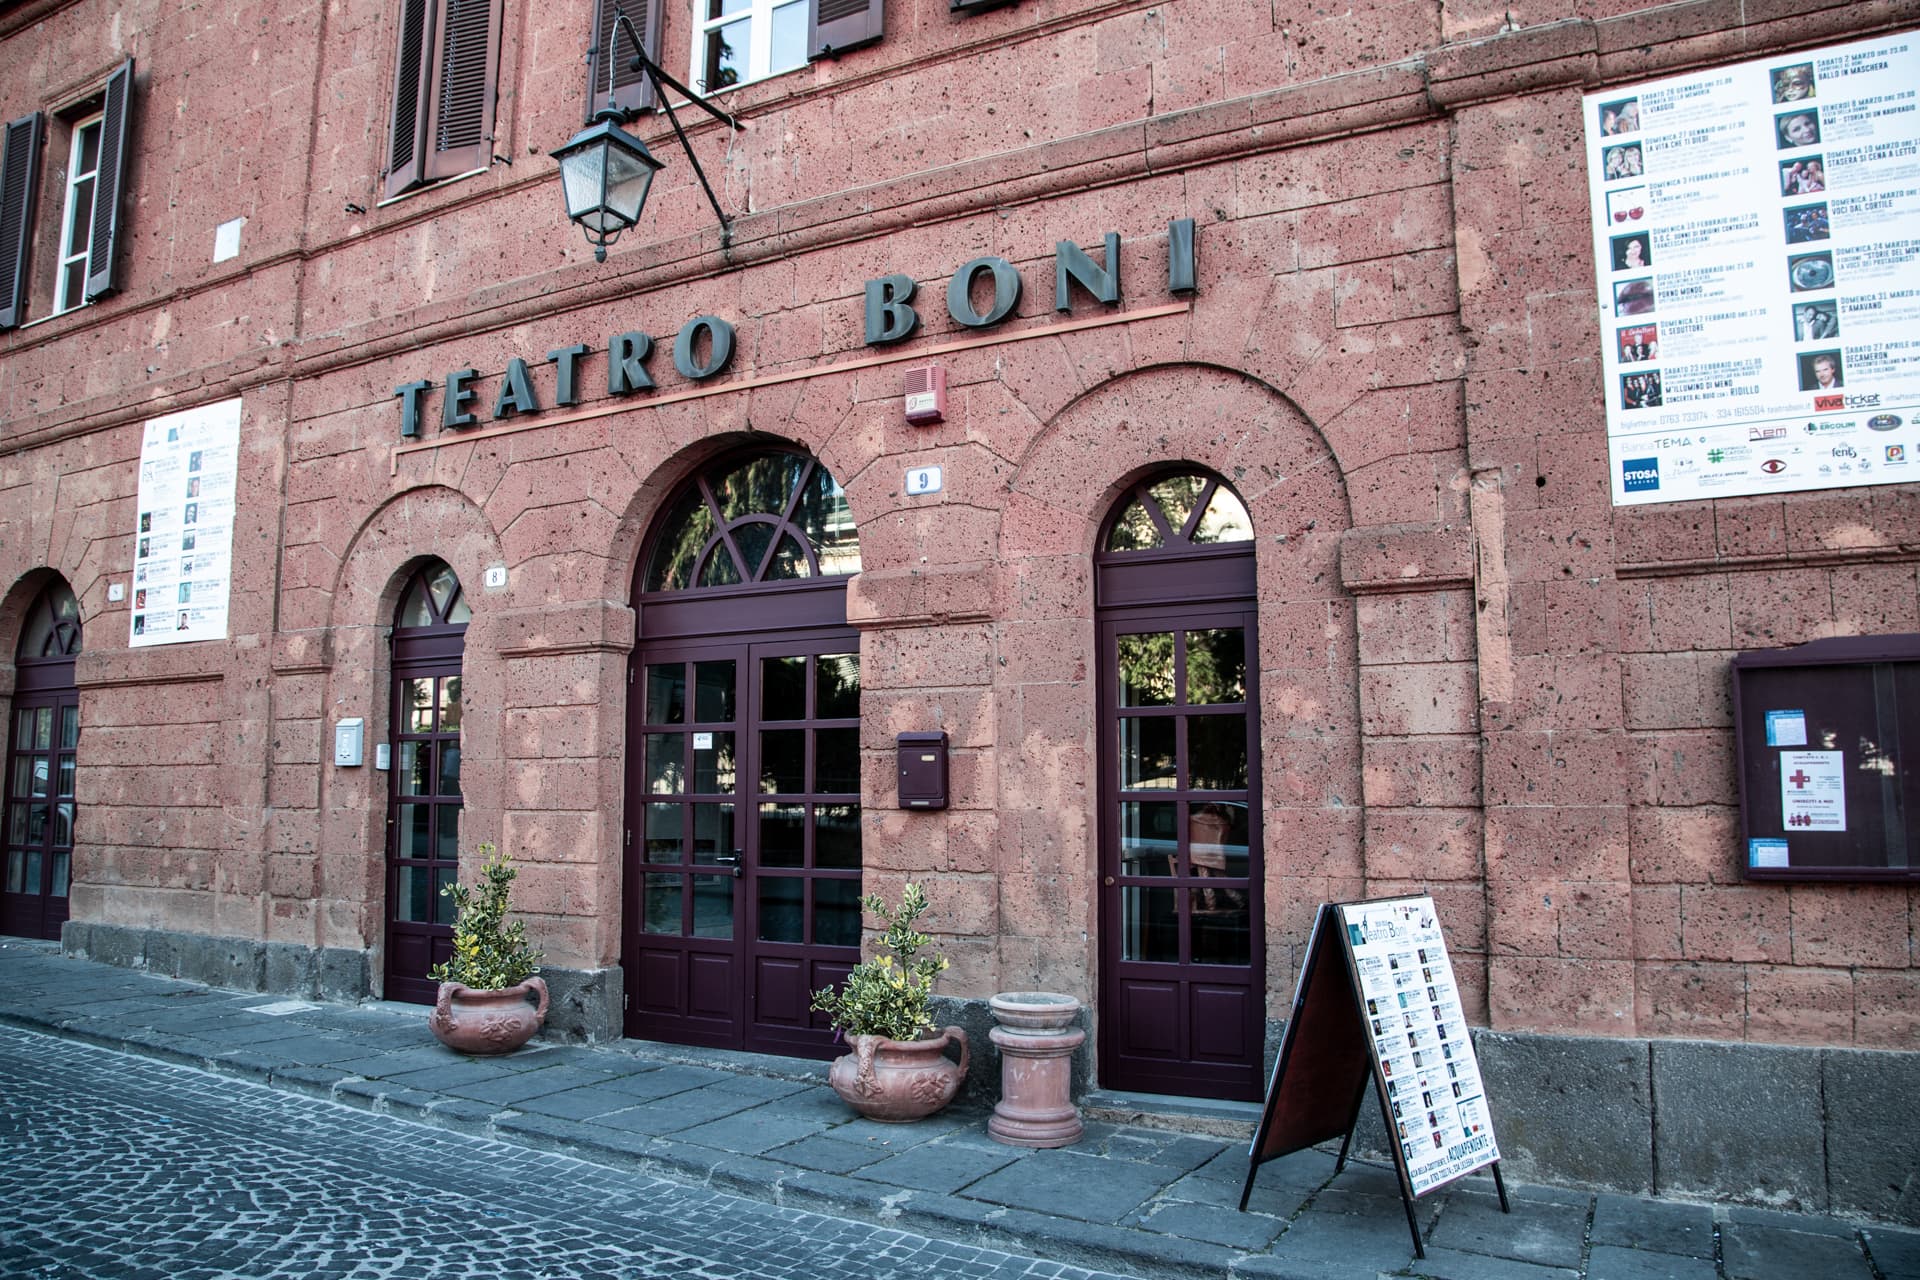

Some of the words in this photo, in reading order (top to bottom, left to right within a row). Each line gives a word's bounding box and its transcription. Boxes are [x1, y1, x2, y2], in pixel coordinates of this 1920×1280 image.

[1819, 72, 1839, 80] BALLO
[1851, 63, 1888, 74] MASCHERA
[1828, 157, 1857, 167] STASERA
[1869, 152, 1886, 160] CENA
[1895, 147, 1916, 156] LETTO
[1866, 201, 1892, 210] CORTILE
[395, 316, 737, 438] TEATRO
[864, 218, 1196, 346] BONI
[1669, 325, 1704, 334] SEDUTTORE
[1846, 353, 1887, 363] DECAMERON
[920, 472, 929, 489] 9
[1625, 471, 1657, 480] STOSA
